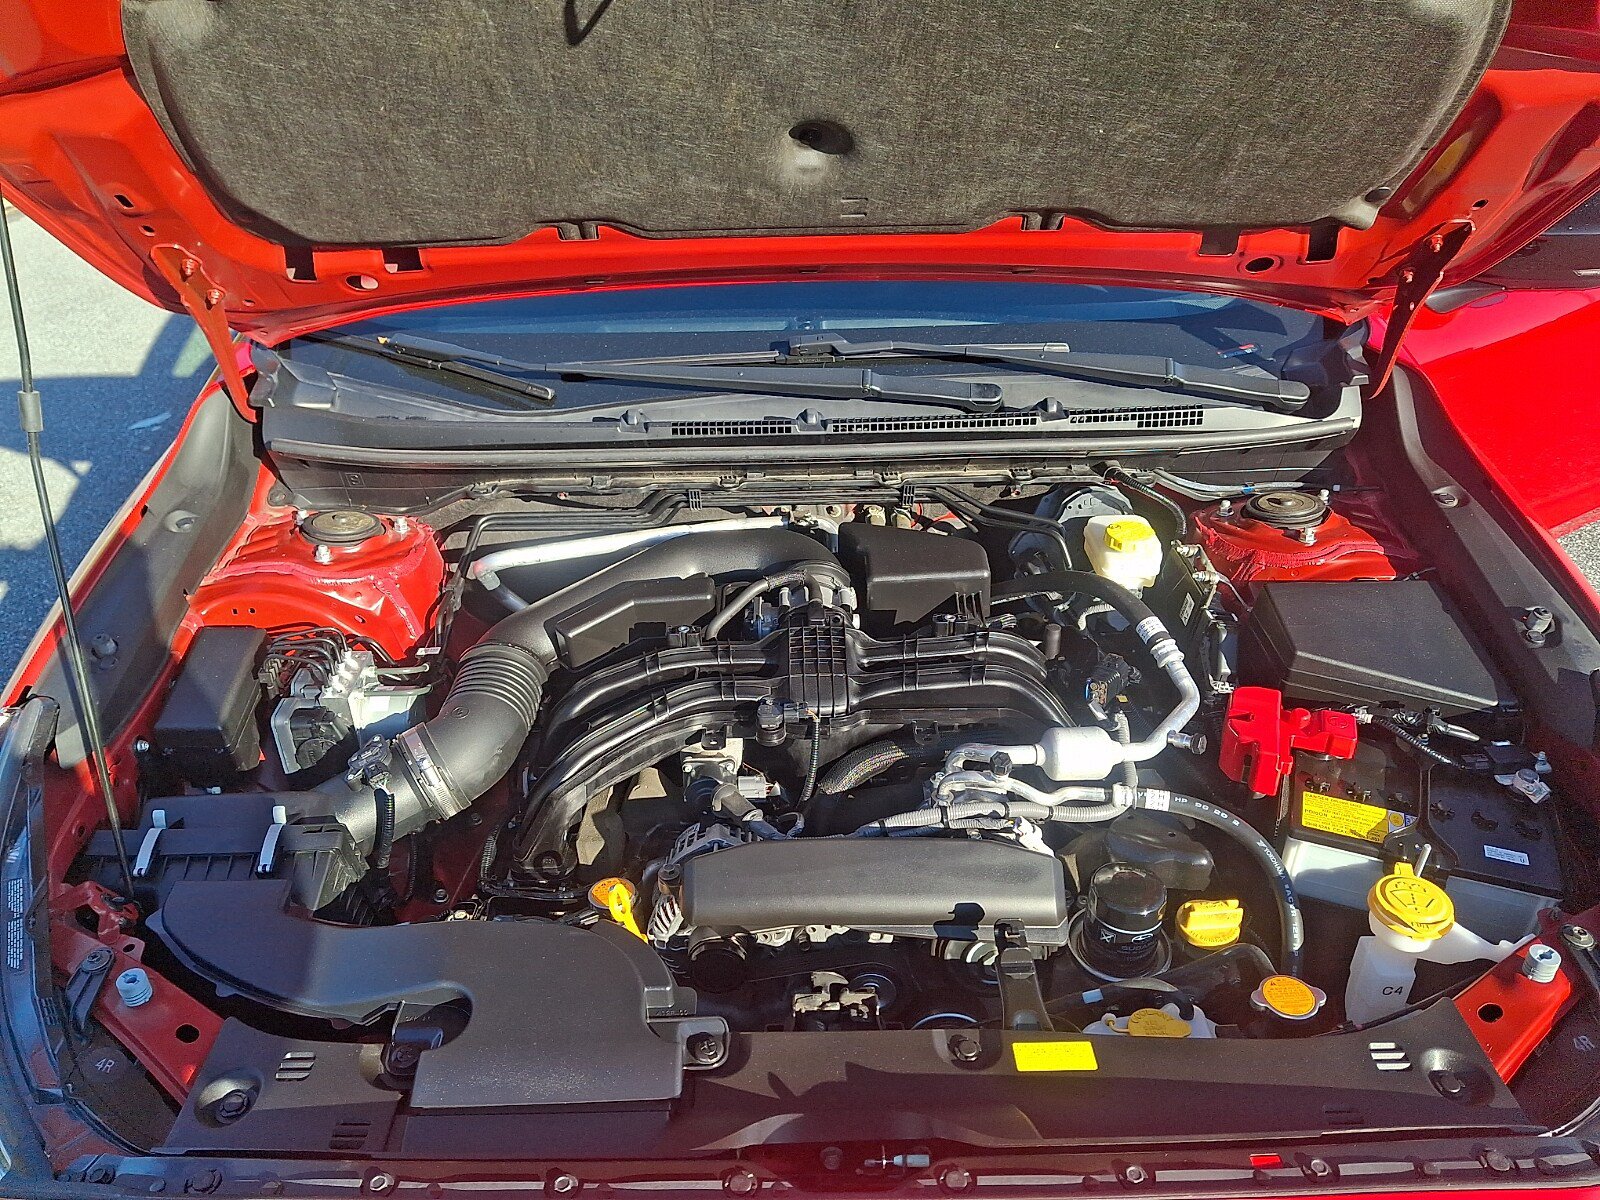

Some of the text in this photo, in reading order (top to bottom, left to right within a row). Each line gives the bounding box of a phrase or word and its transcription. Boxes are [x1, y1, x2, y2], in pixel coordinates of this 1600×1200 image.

[1263, 846, 1287, 880] YOKOHAMA
[1382, 986, 1403, 996] C4
[95, 1058, 115, 1074] 4R
